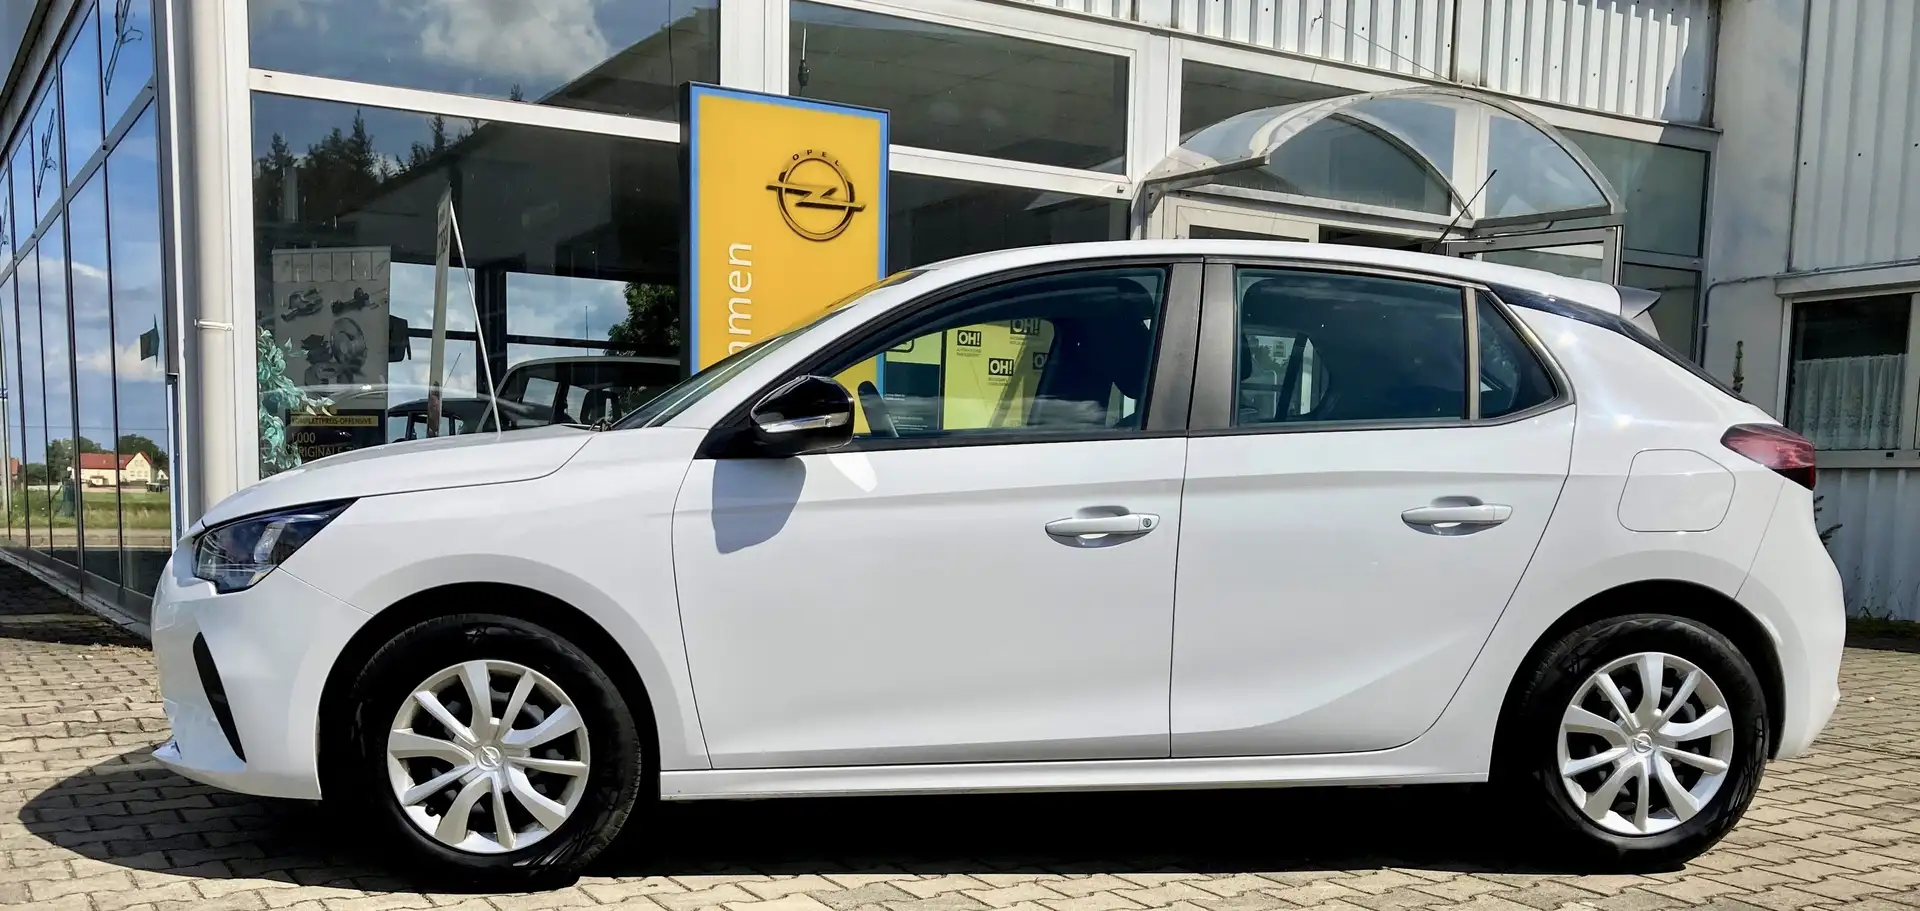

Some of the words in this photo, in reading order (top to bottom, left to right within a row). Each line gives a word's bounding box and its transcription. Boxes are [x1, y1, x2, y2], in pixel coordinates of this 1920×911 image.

[792, 149, 840, 167] OPEL
[1012, 318, 1039, 334] OH!
[958, 331, 980, 346] OH!
[989, 359, 1013, 375] OH!
